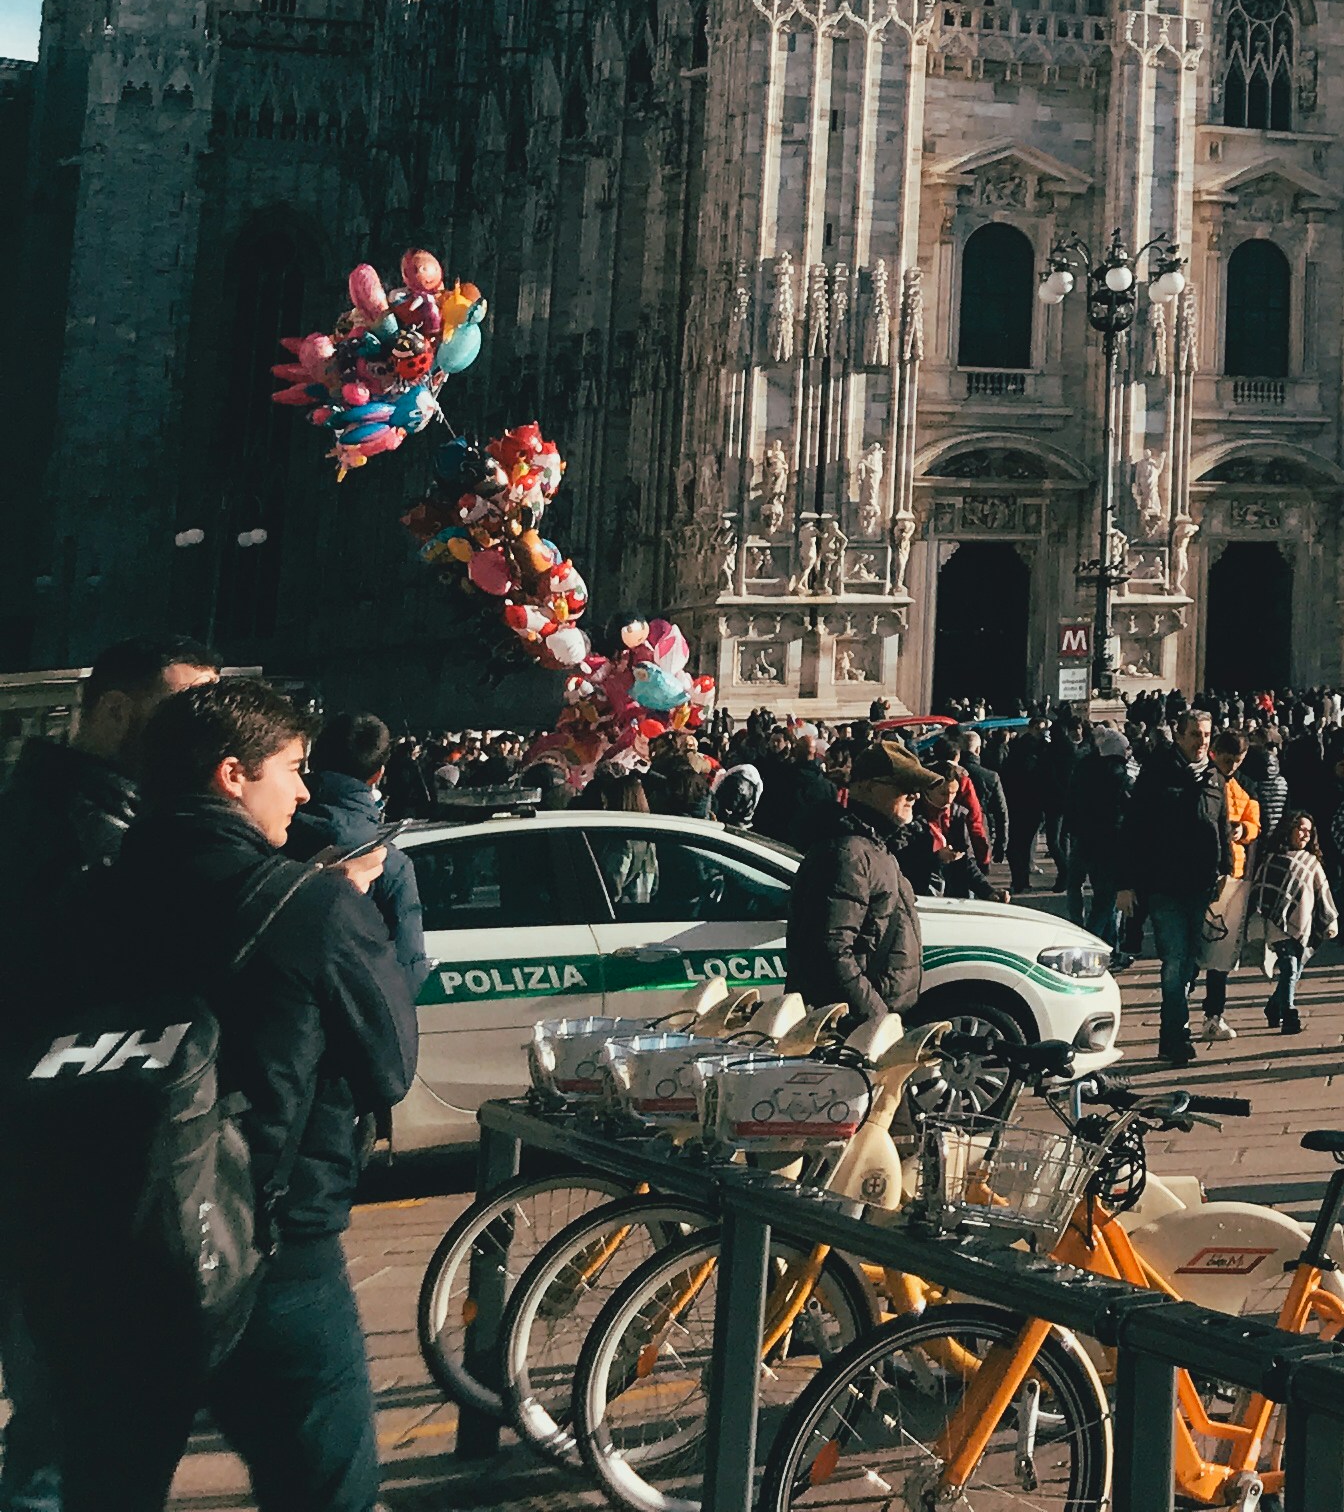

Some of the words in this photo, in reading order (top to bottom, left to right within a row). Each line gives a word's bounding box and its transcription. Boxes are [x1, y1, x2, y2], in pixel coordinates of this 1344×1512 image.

[1062, 630, 1087, 651] M
[440, 964, 588, 995] POLIZIA
[682, 955, 787, 982] LOCAL
[27, 1021, 193, 1079] HH
